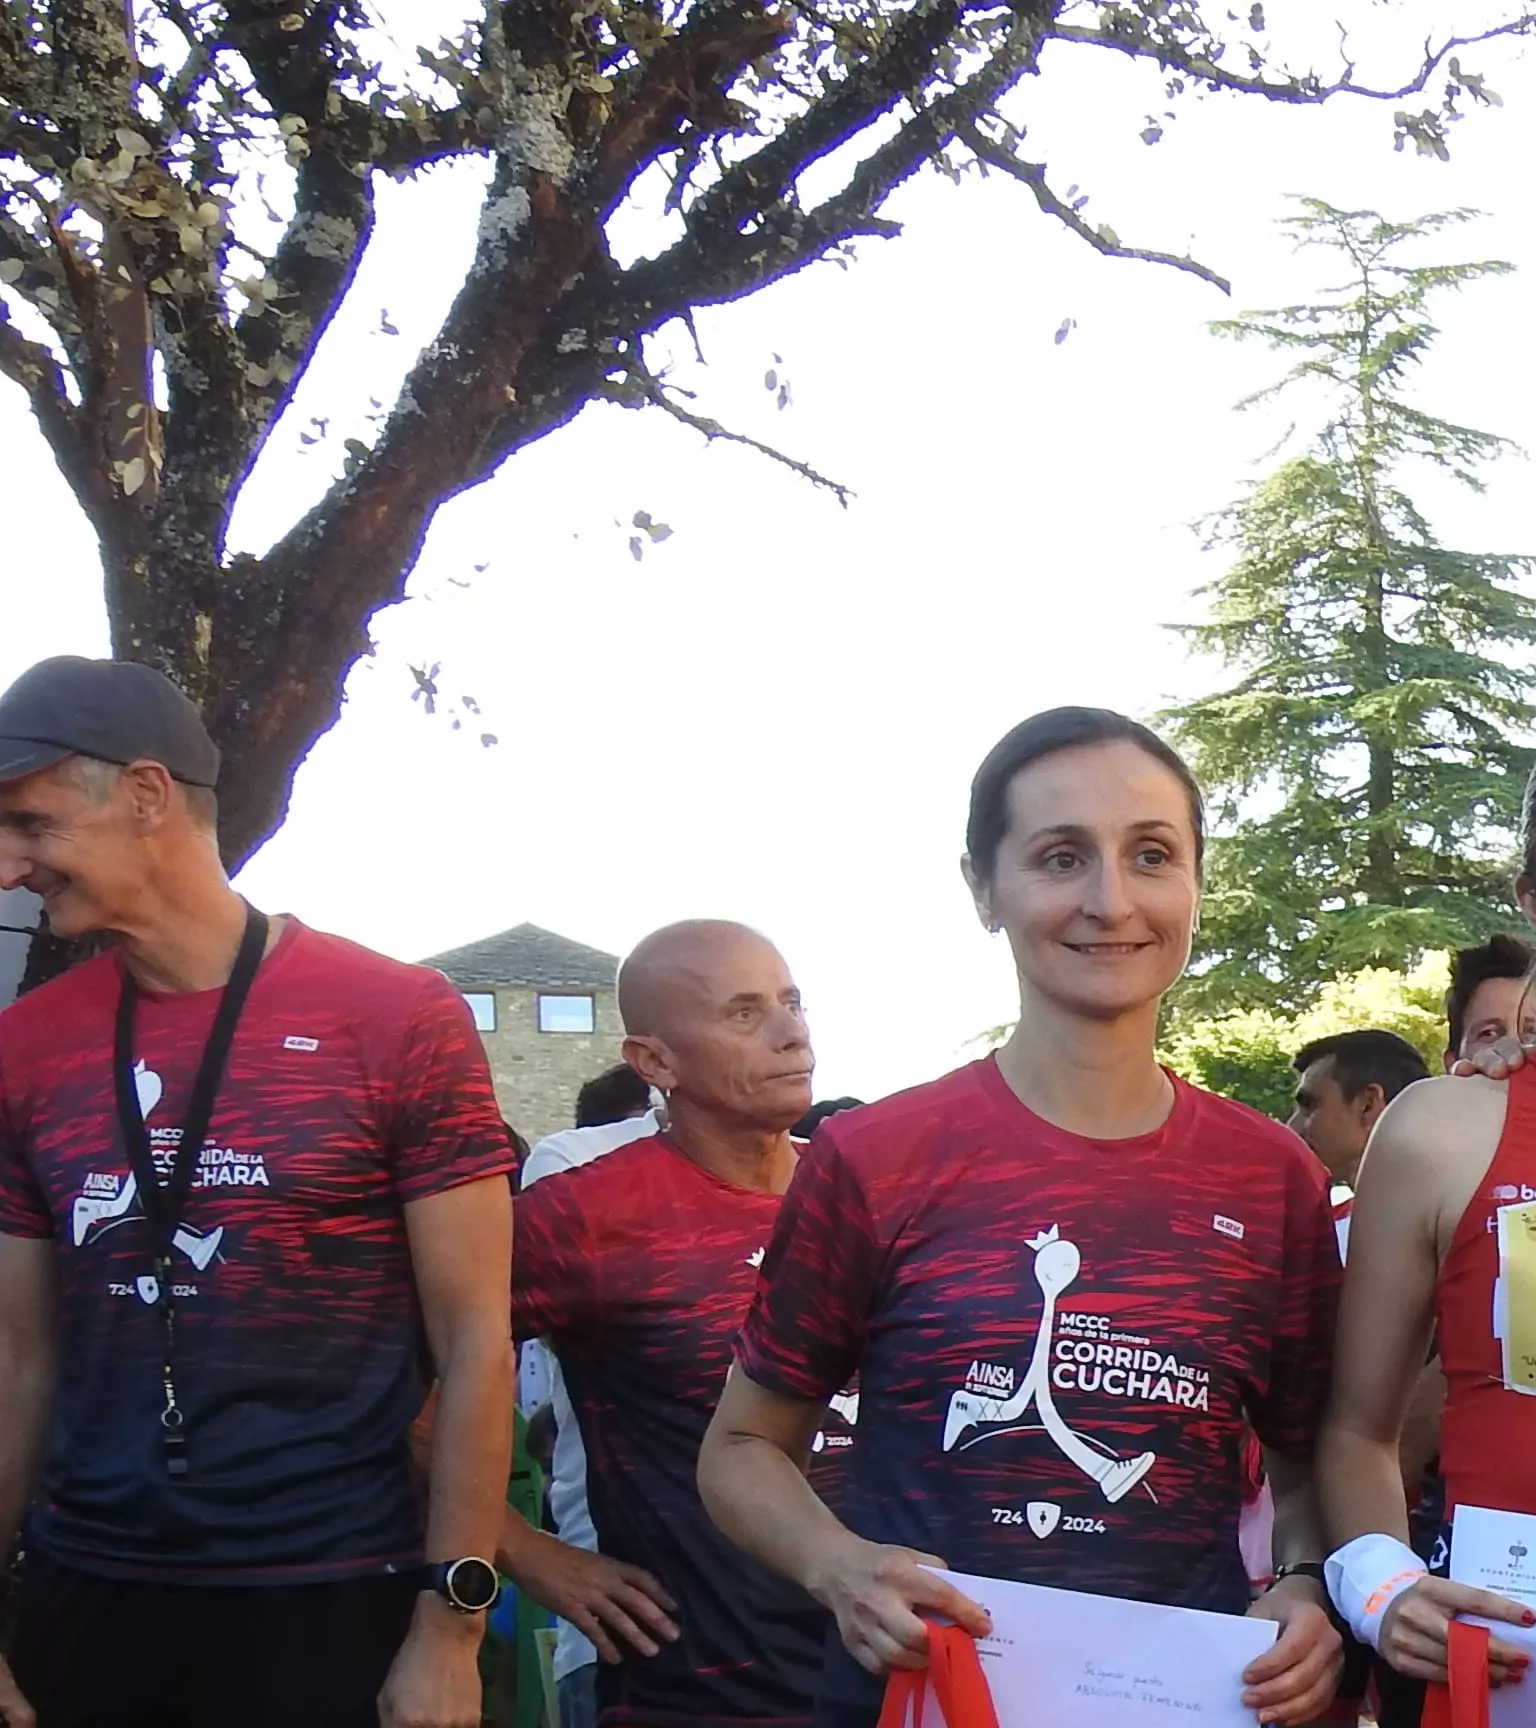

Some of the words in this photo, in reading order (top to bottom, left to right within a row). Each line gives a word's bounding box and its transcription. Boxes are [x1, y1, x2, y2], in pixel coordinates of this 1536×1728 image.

[1060, 1312, 1110, 1330] MCCC
[1055, 1340, 1179, 1377] CORRIDA
[1179, 1365, 1195, 1380] DE
[1196, 1371, 1210, 1383] LA
[1052, 1362, 1209, 1412] CUCHARA
[991, 1508, 1024, 1526] 724
[1062, 1515, 1107, 1534] 2024
